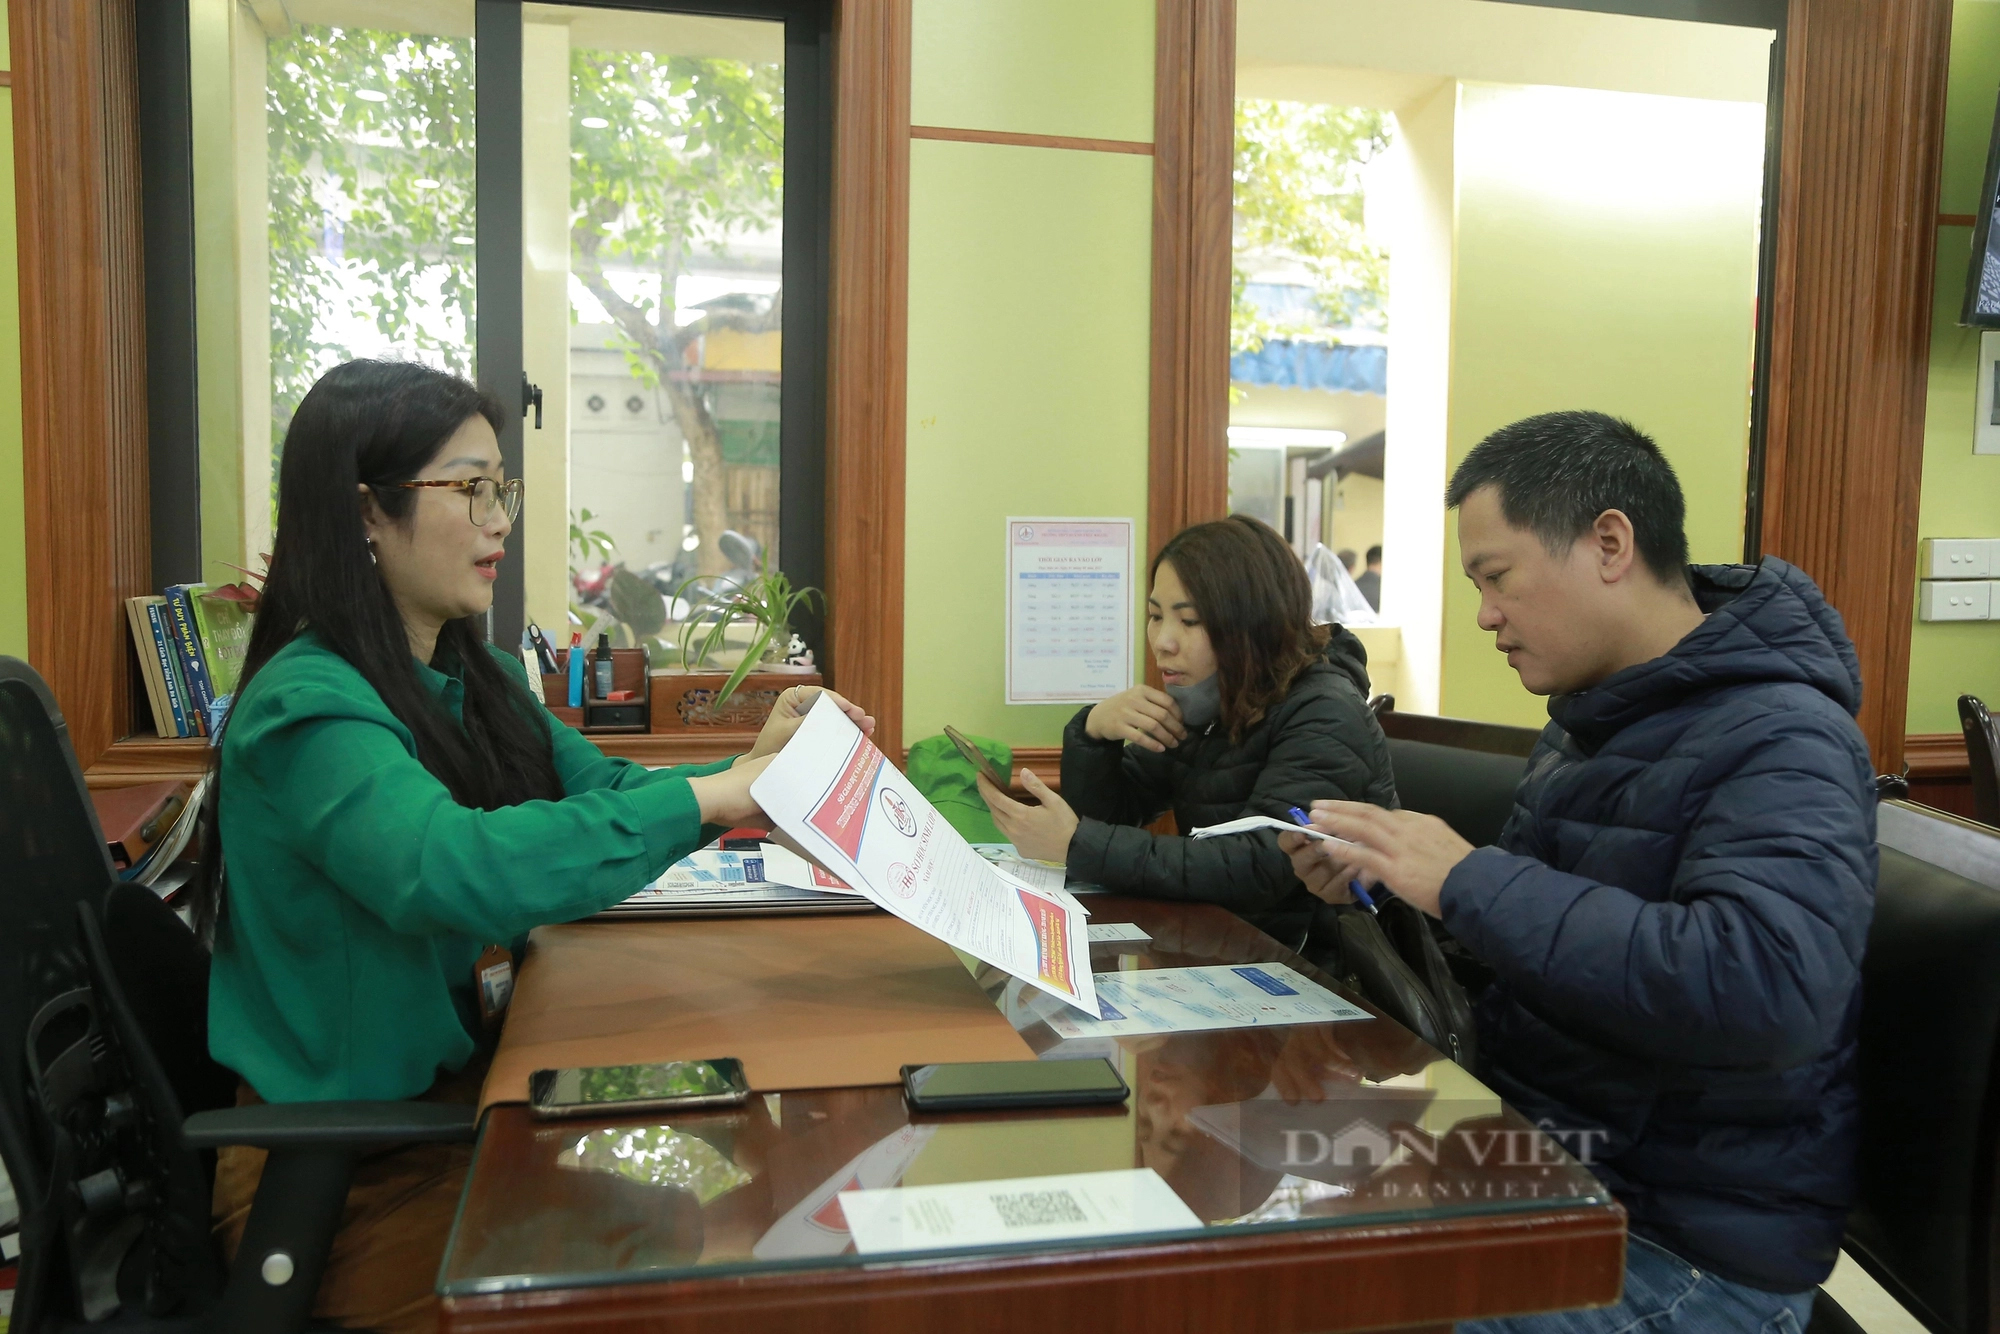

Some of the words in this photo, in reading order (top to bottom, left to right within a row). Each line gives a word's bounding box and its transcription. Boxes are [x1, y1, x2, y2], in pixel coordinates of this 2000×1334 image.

[172, 597, 182, 608] TƯ
[174, 607, 184, 621] DUY
[183, 640, 197, 657] BIỆN
[921, 824, 932, 846] SINH
